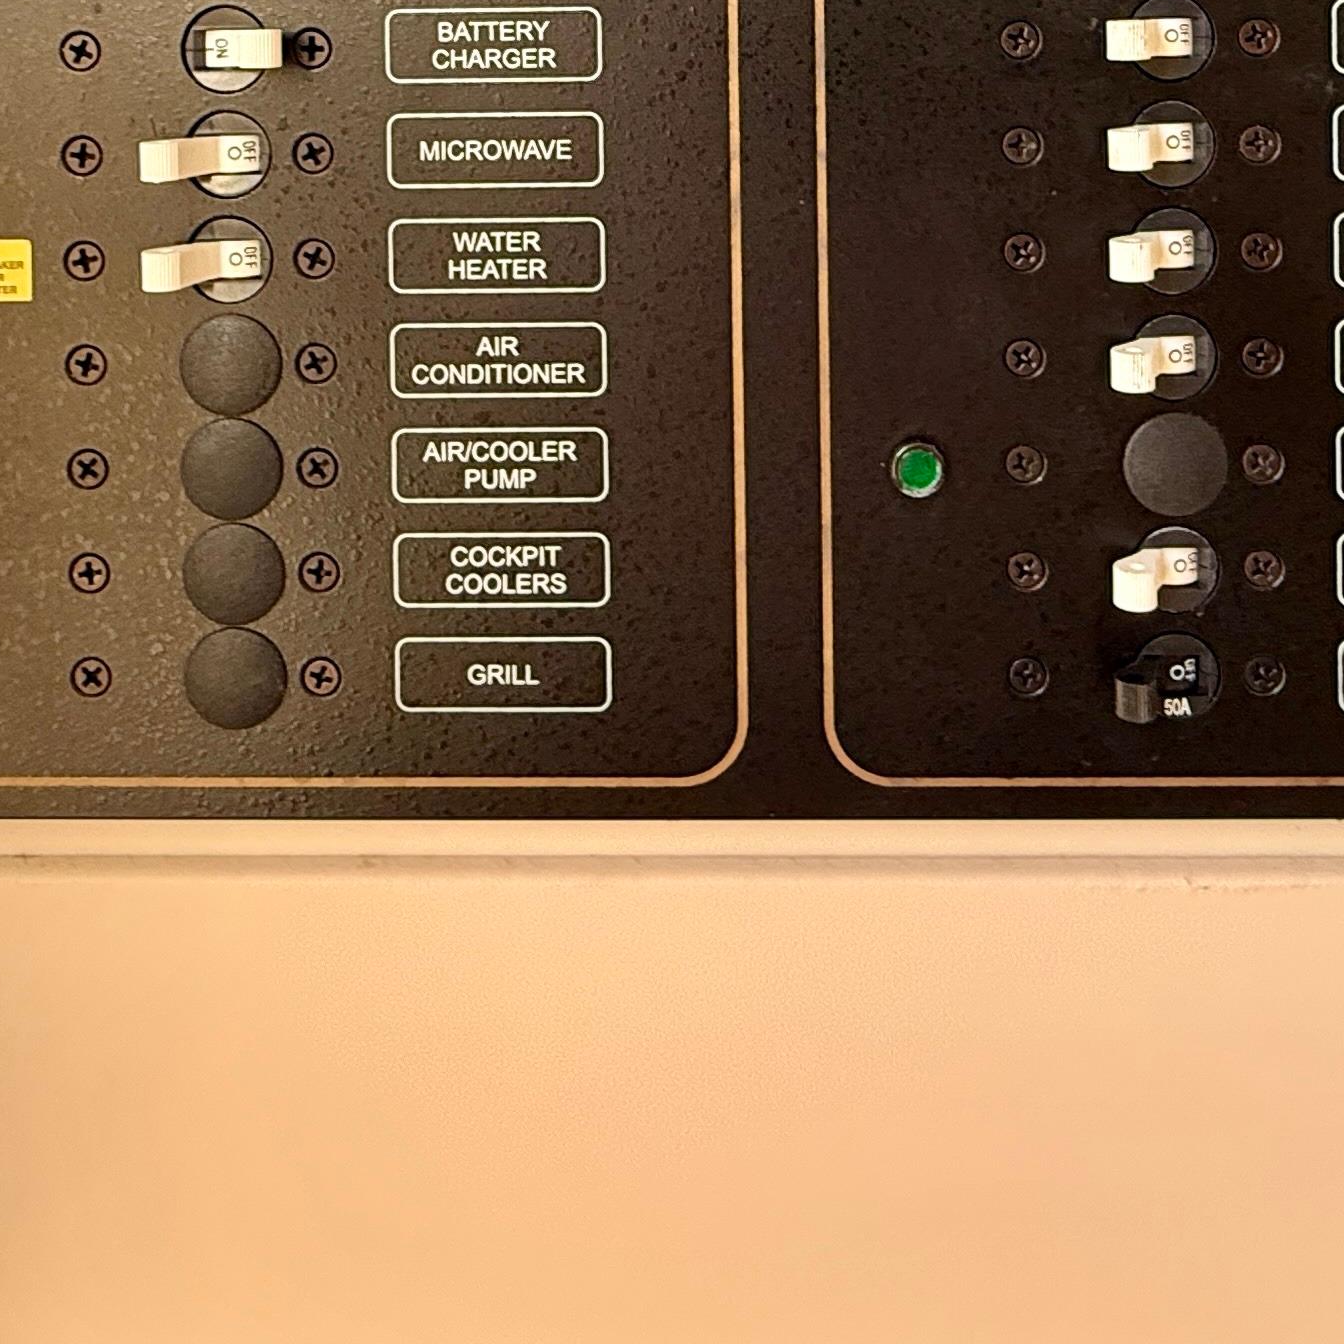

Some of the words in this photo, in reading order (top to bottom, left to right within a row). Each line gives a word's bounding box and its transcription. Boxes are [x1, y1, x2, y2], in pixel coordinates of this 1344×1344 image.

[437, 20, 551, 43] BATTERY
[215, 38, 229, 59] ON
[431, 47, 557, 70] CHARGER
[242, 141, 256, 163] OFF
[419, 138, 573, 162] MICROWAVE
[452, 230, 542, 253] WATER
[244, 246, 257, 268] OFF
[447, 258, 548, 281] HEATER
[475, 335, 520, 357] AIR
[411, 362, 586, 386] CONDITIONER
[422, 440, 578, 463] AIR/COOLER
[464, 468, 537, 490] PUMP
[450, 545, 563, 568] COCKPIT
[444, 572, 568, 595] COOLERS
[466, 663, 541, 686] GRILL
[1164, 697, 1192, 716] 50A
